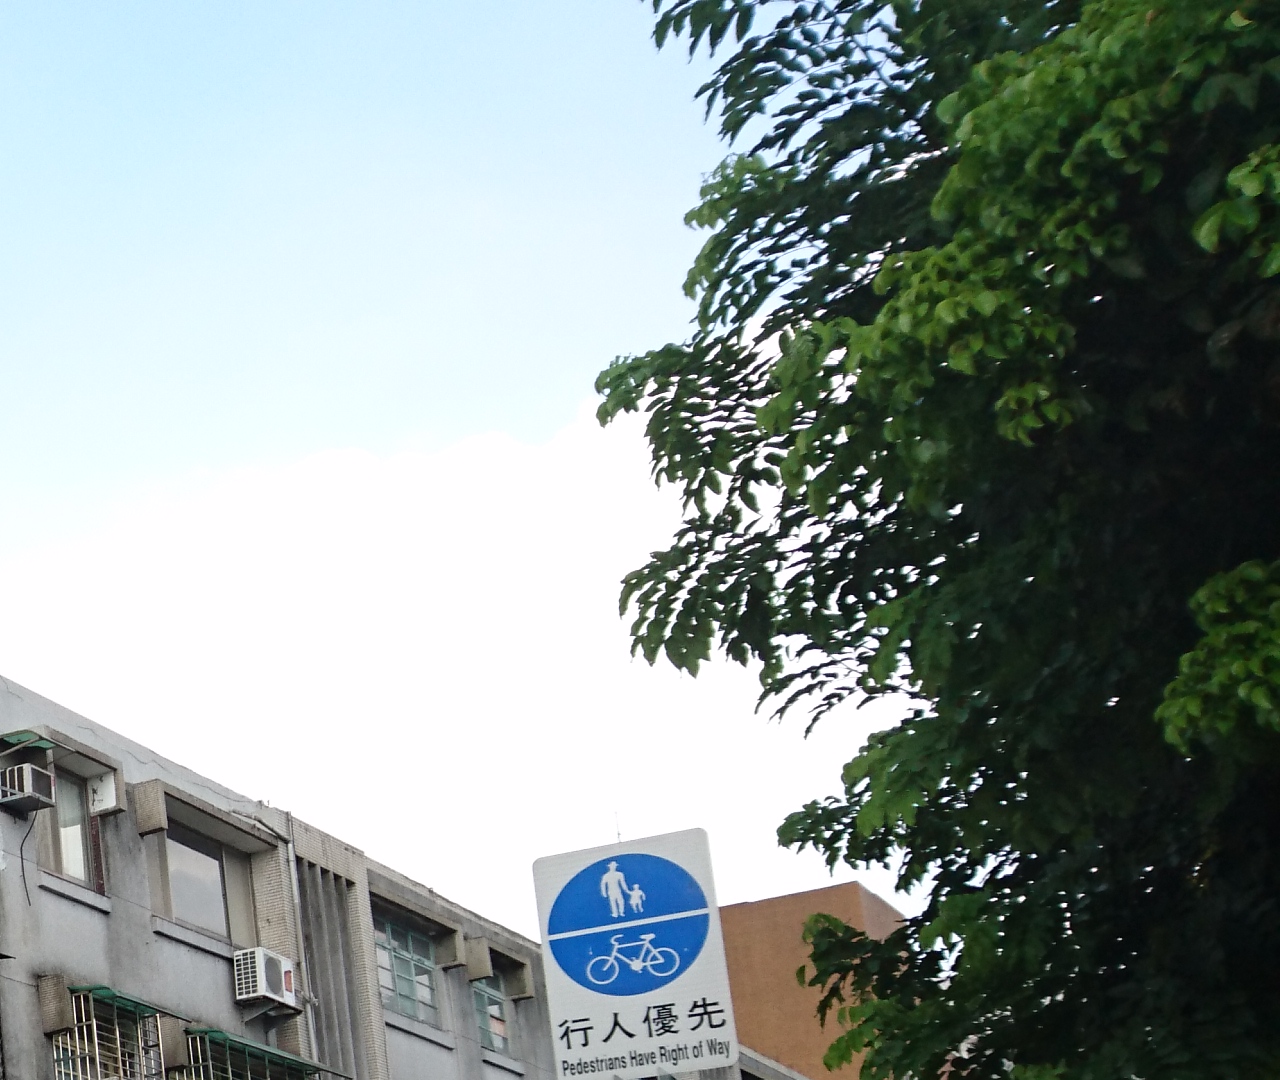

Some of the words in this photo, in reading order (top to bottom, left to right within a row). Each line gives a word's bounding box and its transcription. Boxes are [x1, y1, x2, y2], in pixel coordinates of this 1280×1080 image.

[558, 997, 727, 1050] 行人優先
[562, 1054, 627, 1077] Pedestrians
[630, 1049, 657, 1068] Have
[659, 1044, 690, 1067] Right
[692, 1041, 704, 1059] of
[706, 1038, 730, 1059] Way
